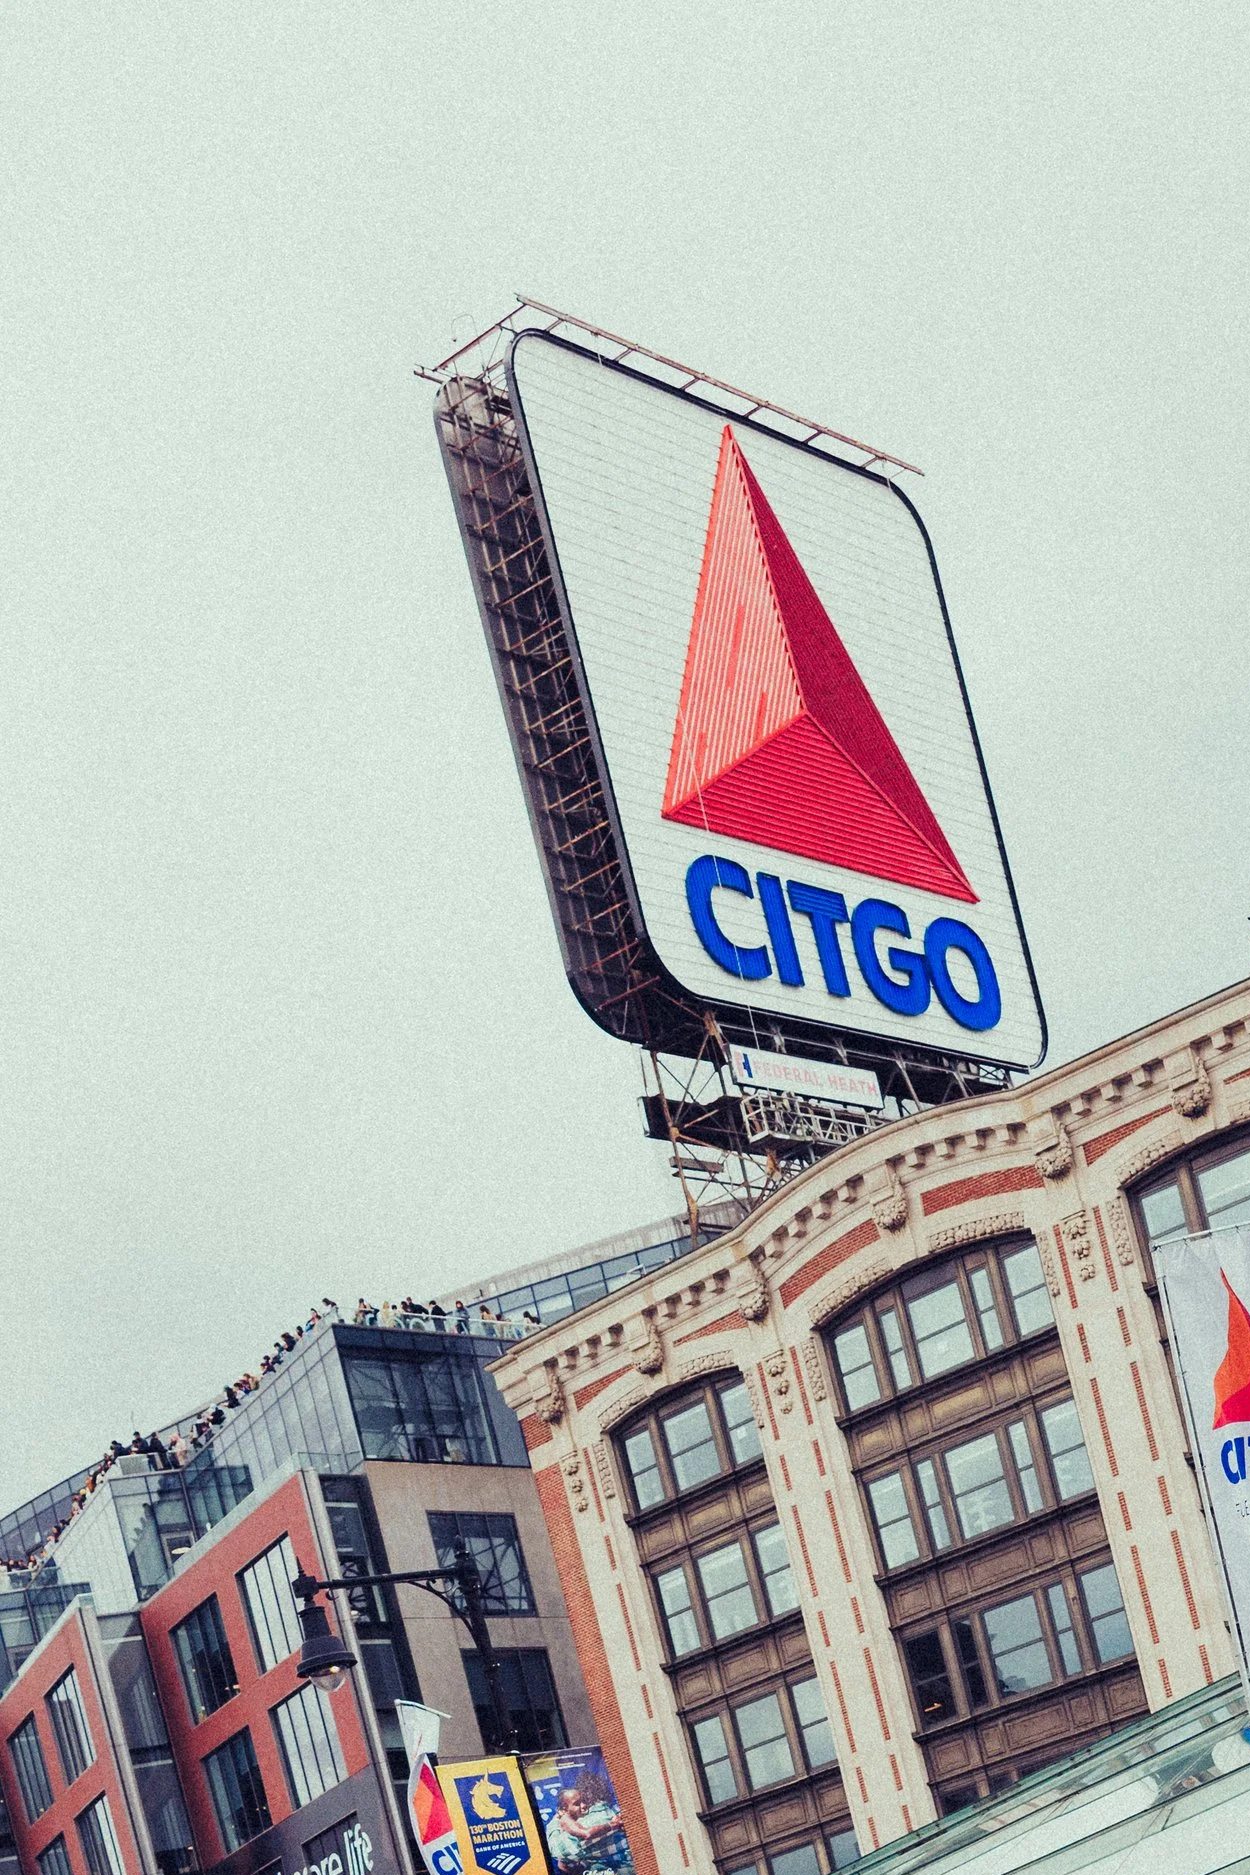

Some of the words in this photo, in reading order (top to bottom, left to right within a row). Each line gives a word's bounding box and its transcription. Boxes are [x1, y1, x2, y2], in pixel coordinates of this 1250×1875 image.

[685, 853, 1002, 1032] CITGO
[752, 1060, 824, 1088] FEDERAL
[828, 1074, 878, 1097] HEATH
[487, 1819, 521, 1833] BOSTON
[472, 1829, 524, 1845] MARATHON
[475, 1845, 491, 1853] BANK
[492, 1843, 500, 1851] OF
[500, 1840, 526, 1850] AMERICA
